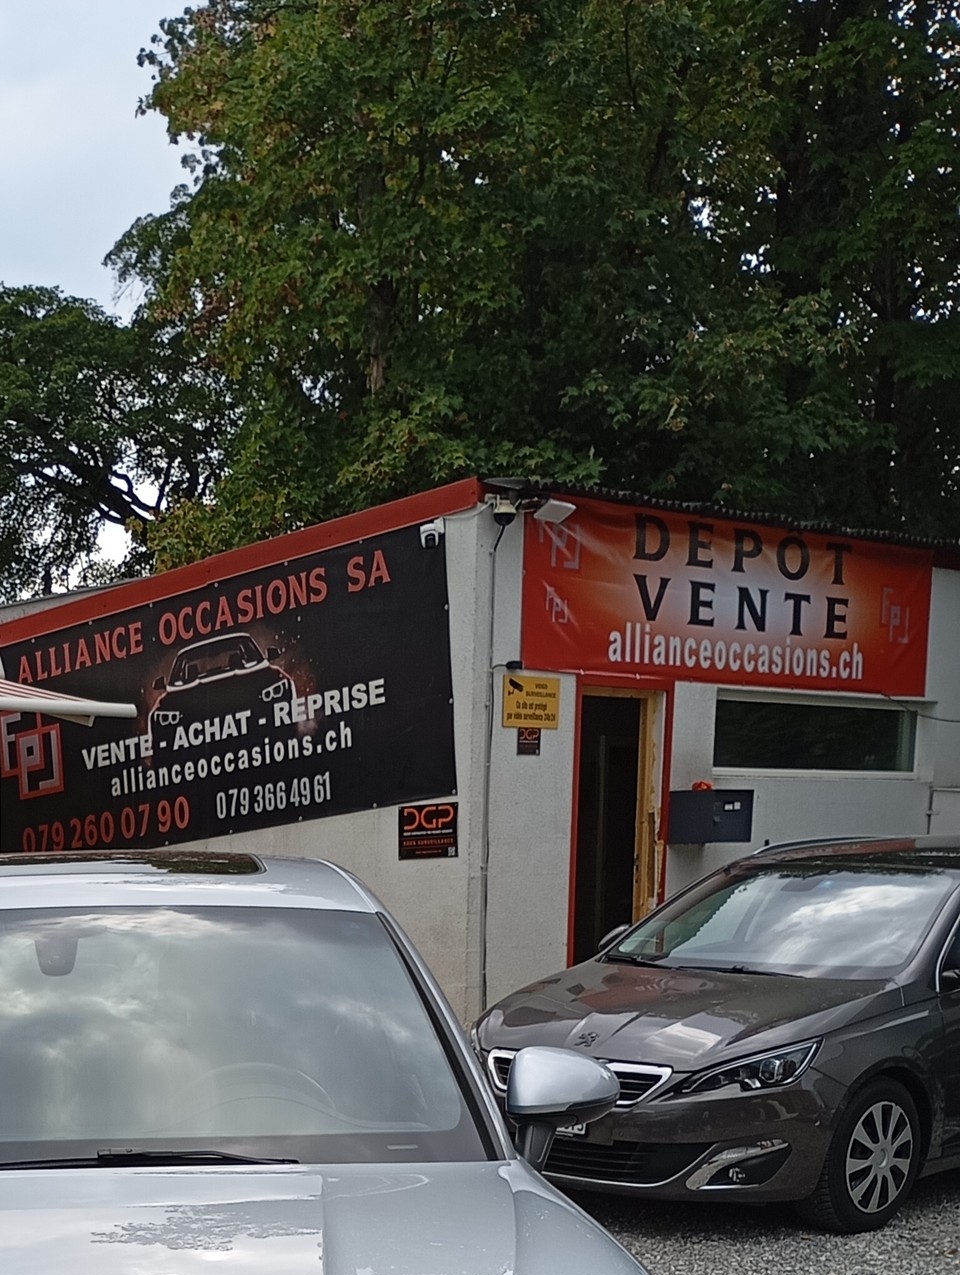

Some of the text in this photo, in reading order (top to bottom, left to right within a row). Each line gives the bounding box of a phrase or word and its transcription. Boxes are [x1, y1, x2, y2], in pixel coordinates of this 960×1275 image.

[17, 549, 392, 684] ALLIANCE OCCASIONS SA
[633, 573, 849, 640] VENTE
[608, 621, 863, 680] allianceoccasions.ch
[81, 733, 154, 771] VENTE
[173, 709, 252, 752] ACHAT
[273, 678, 386, 728] REPRISE
[111, 720, 353, 798] allianceoccasions.ch
[22, 795, 191, 854] 079 260 07 90
[216, 770, 332, 819] 079 366 49 61
